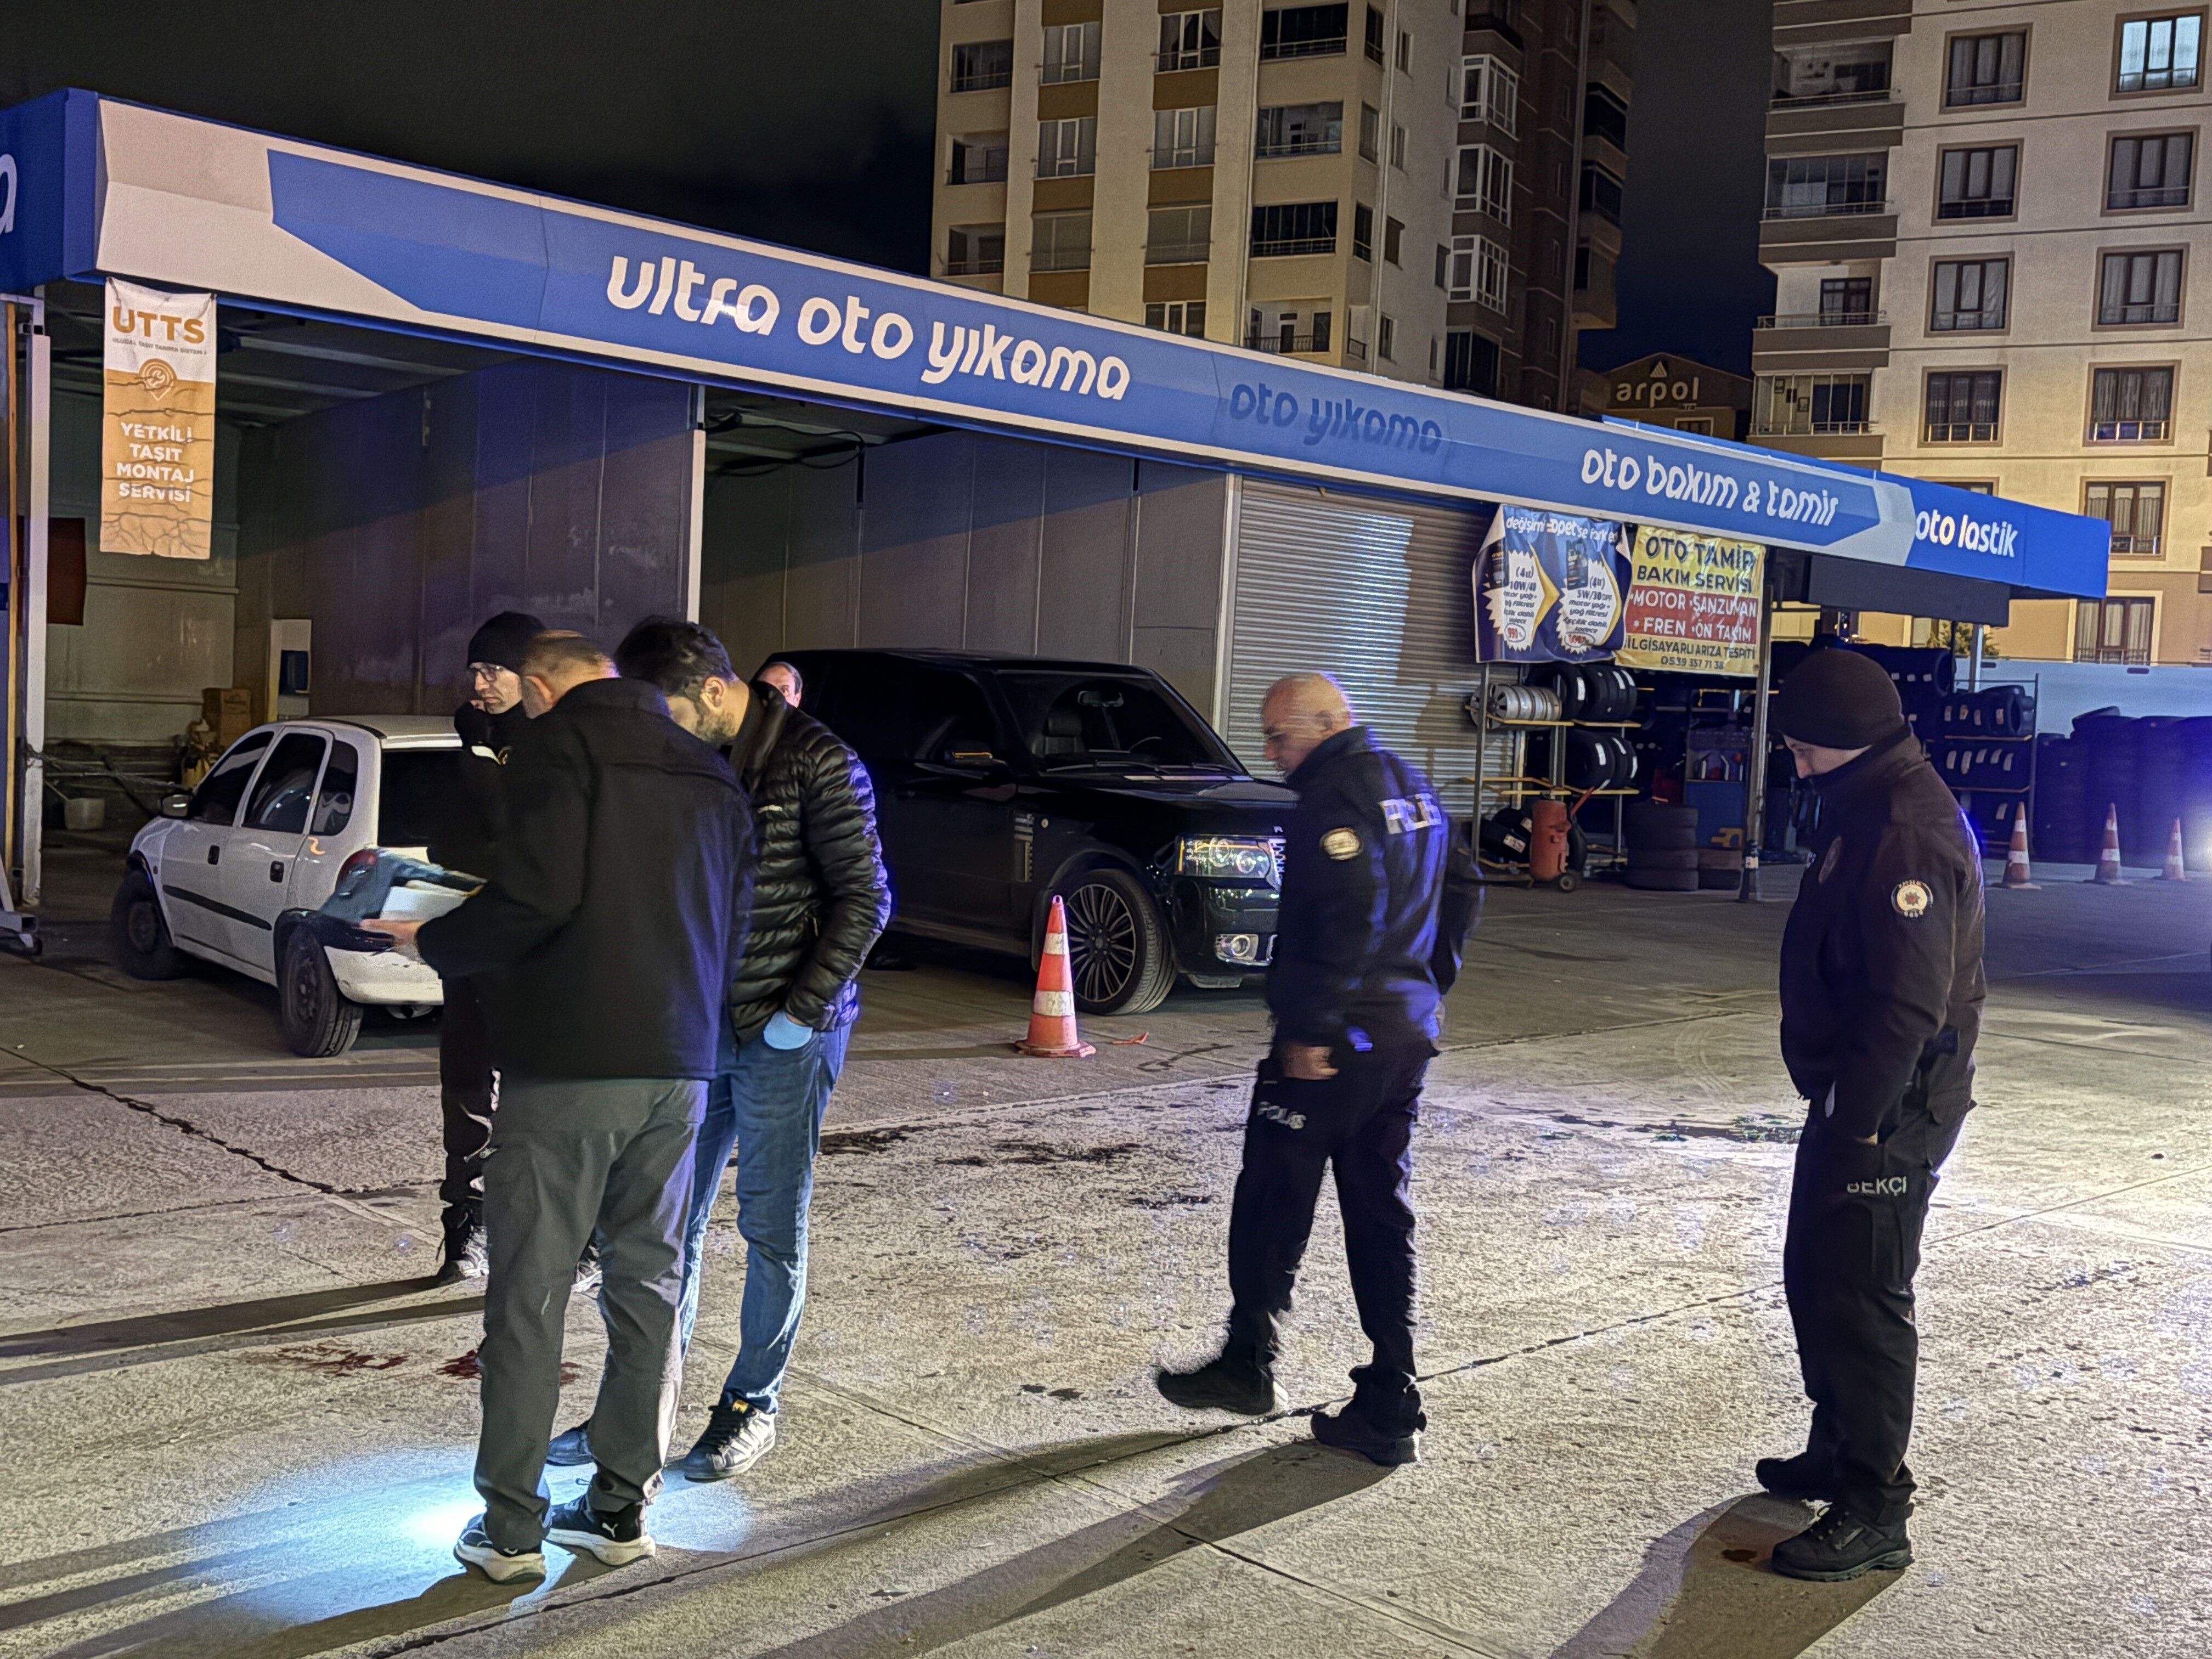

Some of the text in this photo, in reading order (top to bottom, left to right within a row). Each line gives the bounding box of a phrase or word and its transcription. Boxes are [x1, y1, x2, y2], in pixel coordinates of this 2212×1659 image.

[114, 306, 205, 343] UTTS
[606, 256, 1131, 400] ultra oto yıkama
[1616, 377, 1699, 408] arpol
[1229, 382, 1442, 454] oto yıkama
[121, 422, 193, 442] YETKİLİ
[129, 443, 182, 461] TAŞIT
[116, 462, 194, 483] MONTAJ
[119, 483, 190, 502] SERVİSİ
[1581, 449, 1838, 526] oto bakım & tamir
[1506, 516, 1545, 533] değişimi
[1590, 528, 1607, 541] fark
[1915, 509, 2018, 557] oto lastik
[1646, 536, 1755, 572] OTO TAMİR
[1637, 565, 1690, 586] BAKIM
[1633, 589, 1686, 610] MOTOR
[1570, 608, 1584, 617] yağ
[1644, 617, 1751, 642] FREN ÖN TAKIM
[1661, 656, 1724, 669] 0539 357 71 38
[1696, 647, 1721, 657] ARIZA
